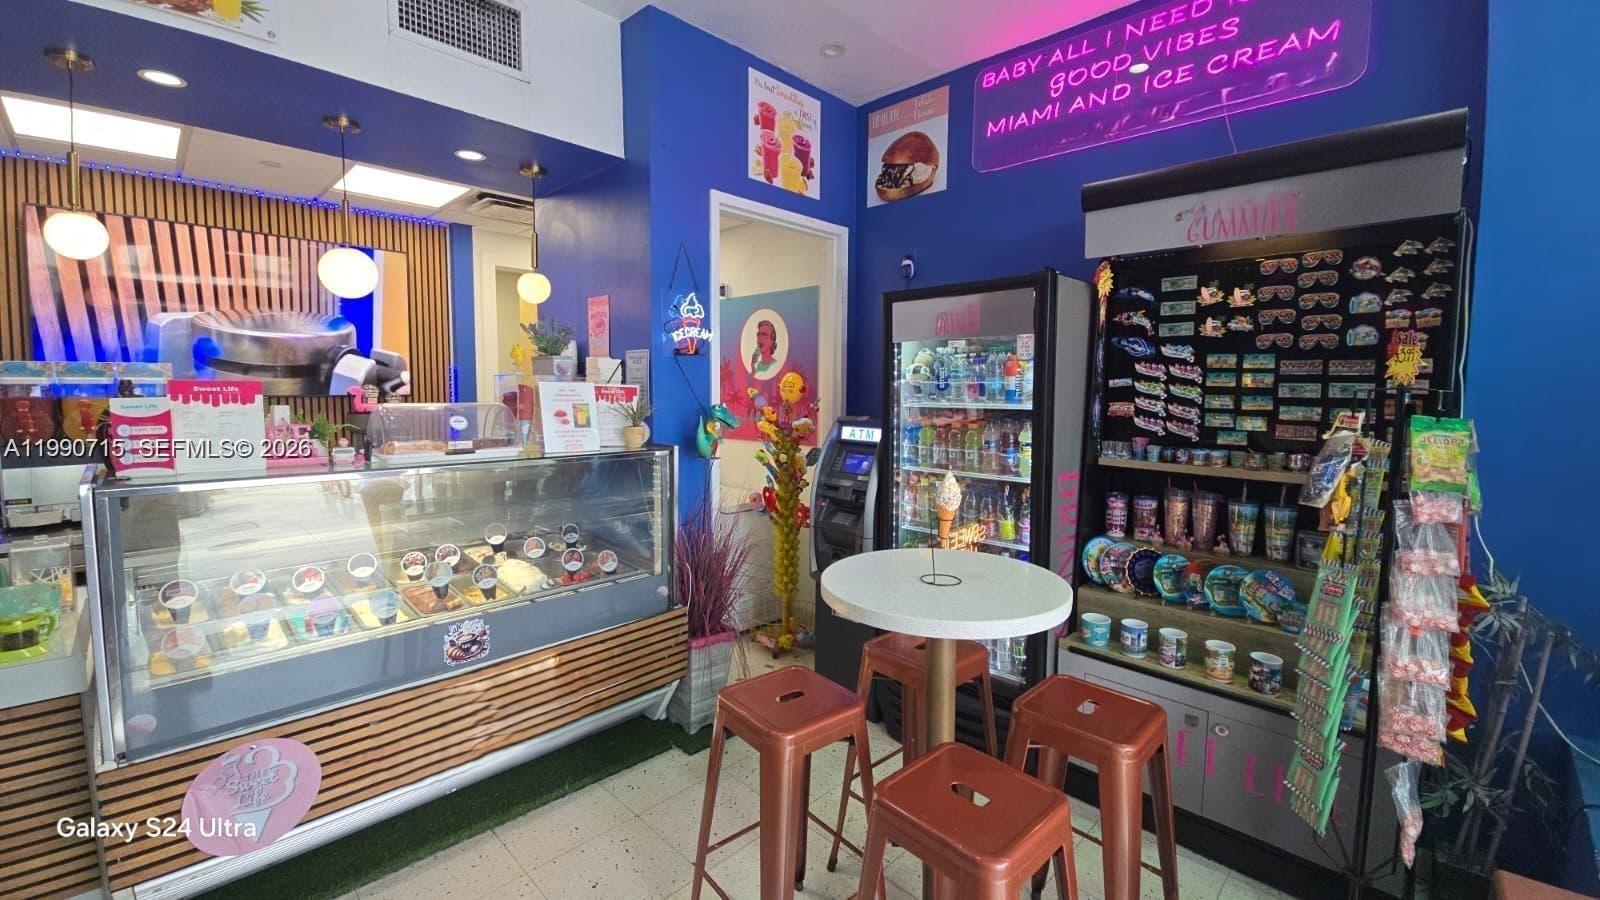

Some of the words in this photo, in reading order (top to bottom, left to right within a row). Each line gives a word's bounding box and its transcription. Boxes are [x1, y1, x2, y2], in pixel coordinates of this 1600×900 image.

[982, 55, 1043, 88] BABY
[1048, 40, 1097, 67] ALL
[1105, 31, 1113, 49] I
[1126, 0, 1214, 41] NEED
[1143, 17, 1241, 62] VIBES
[986, 101, 1061, 138] MIAMI
[1067, 83, 1132, 114] AND
[1144, 63, 1195, 94] ICE
[1206, 19, 1341, 75] CREAM
[848, 428, 875, 440] ATM
